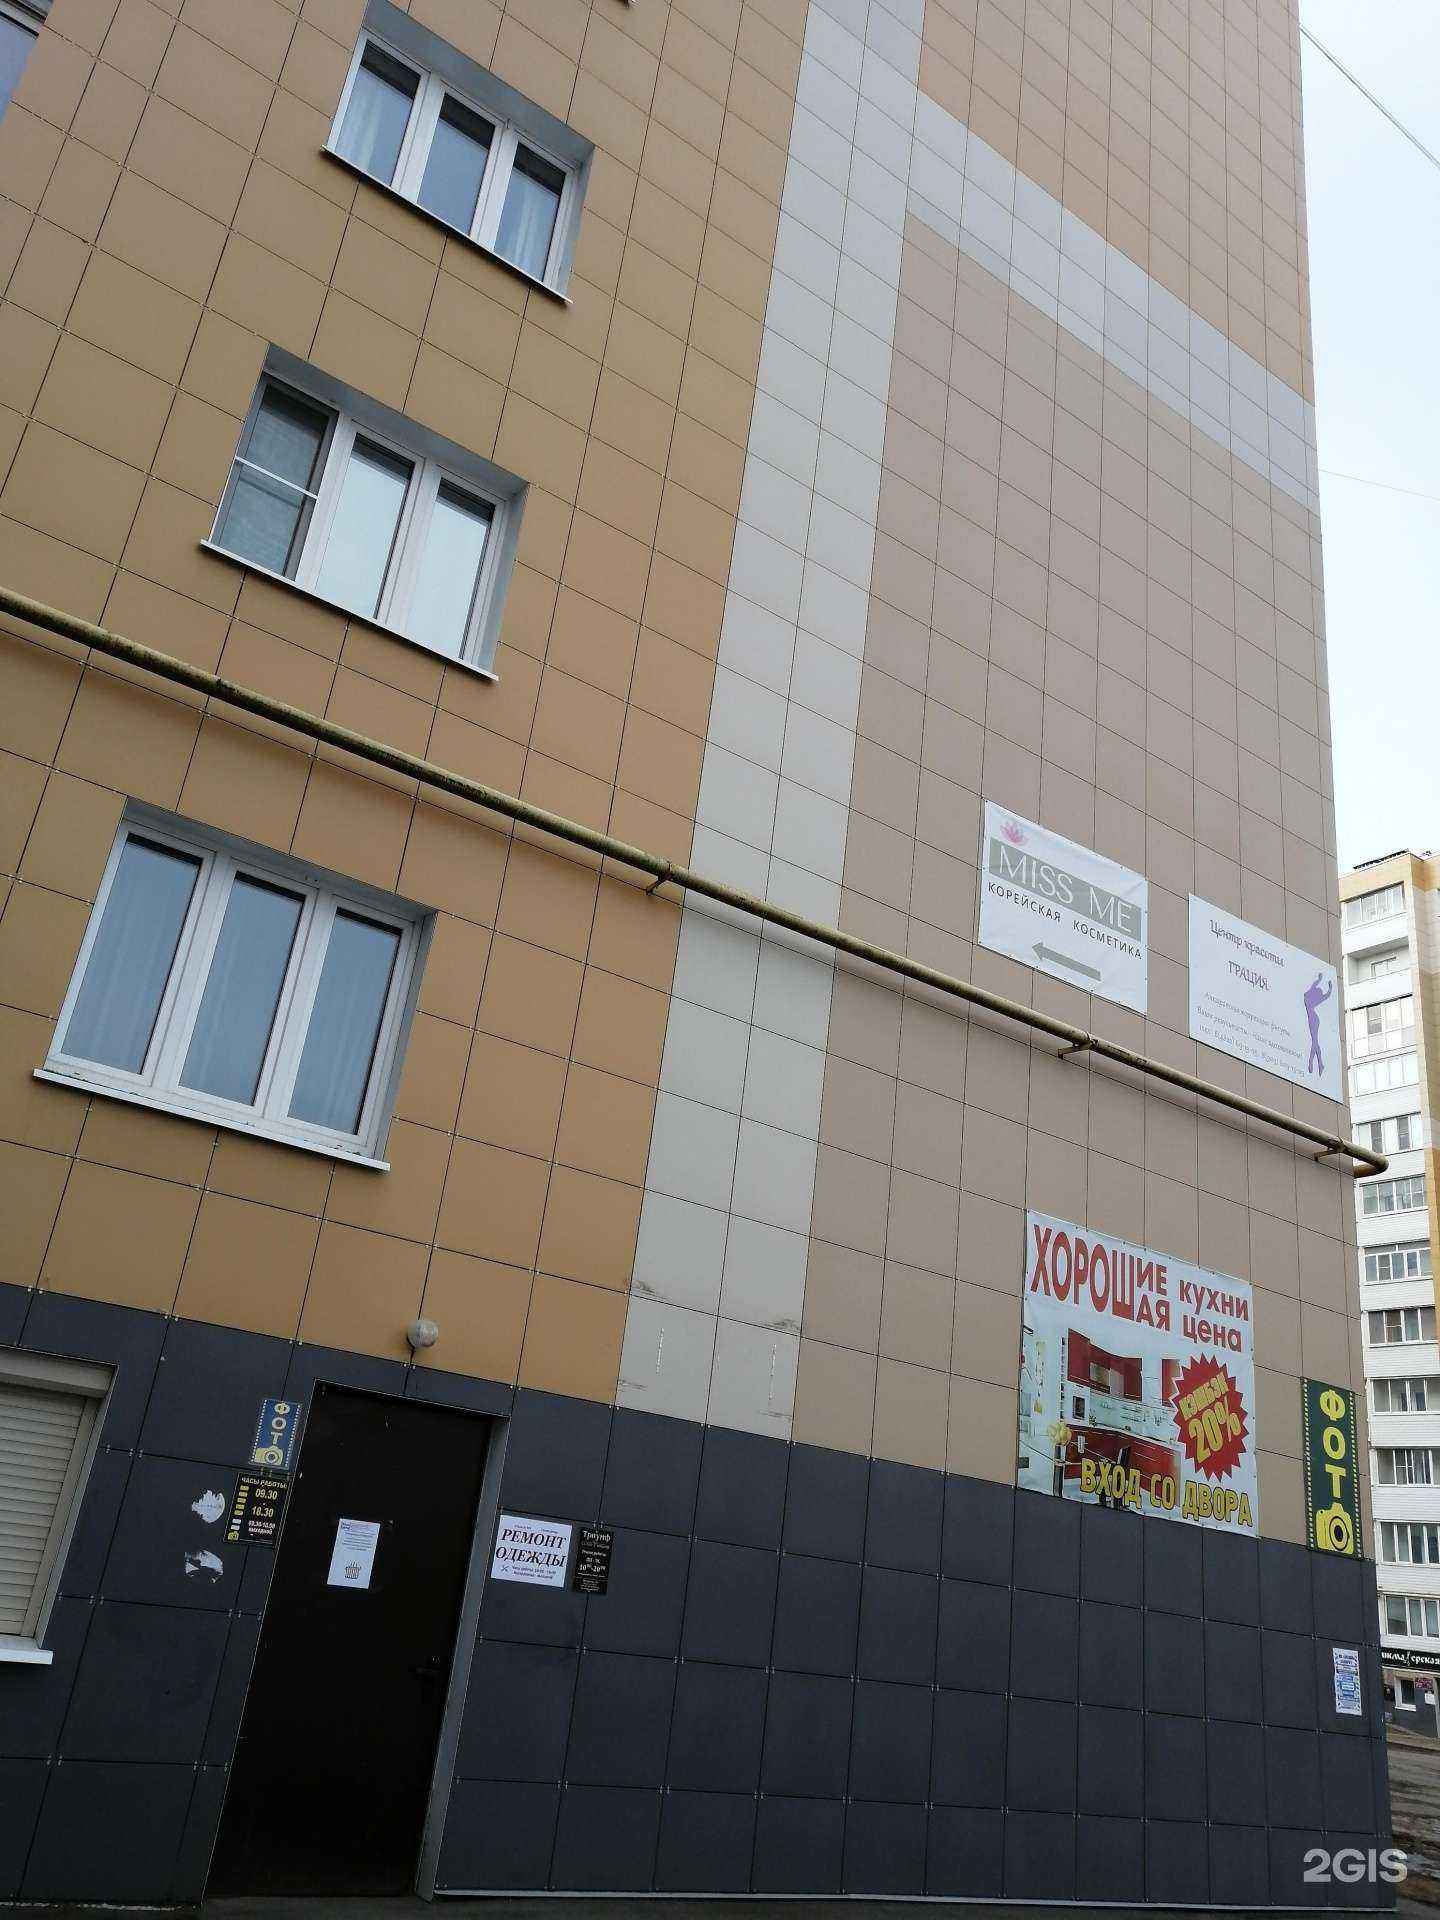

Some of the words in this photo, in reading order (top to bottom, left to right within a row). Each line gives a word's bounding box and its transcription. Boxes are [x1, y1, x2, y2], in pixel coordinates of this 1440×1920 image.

[998, 845, 1074, 905] MISS
[1089, 886, 1133, 933] ME
[987, 881, 1062, 924] КОРЕЙСКАЯ
[1072, 918, 1142, 960] КОСМЕТИКА
[1209, 919, 1243, 949] Центр
[1227, 960, 1270, 991] ГРАЦИЯ
[1179, 1278, 1250, 1322] кухни
[1182, 1311, 1243, 1354] цена
[1188, 1393, 1242, 1464] 20%
[255, 1488, 278, 1500] 09.30
[1079, 1457, 1143, 1511] ВХОД
[1150, 1471, 1177, 1512] СО
[1181, 1478, 1254, 1528] ДВОРА
[251, 1506, 274, 1518] 18.30
[495, 1546, 567, 1568] ОДЕЖДЫ
[500, 1528, 567, 1549] РЕМОНТ
